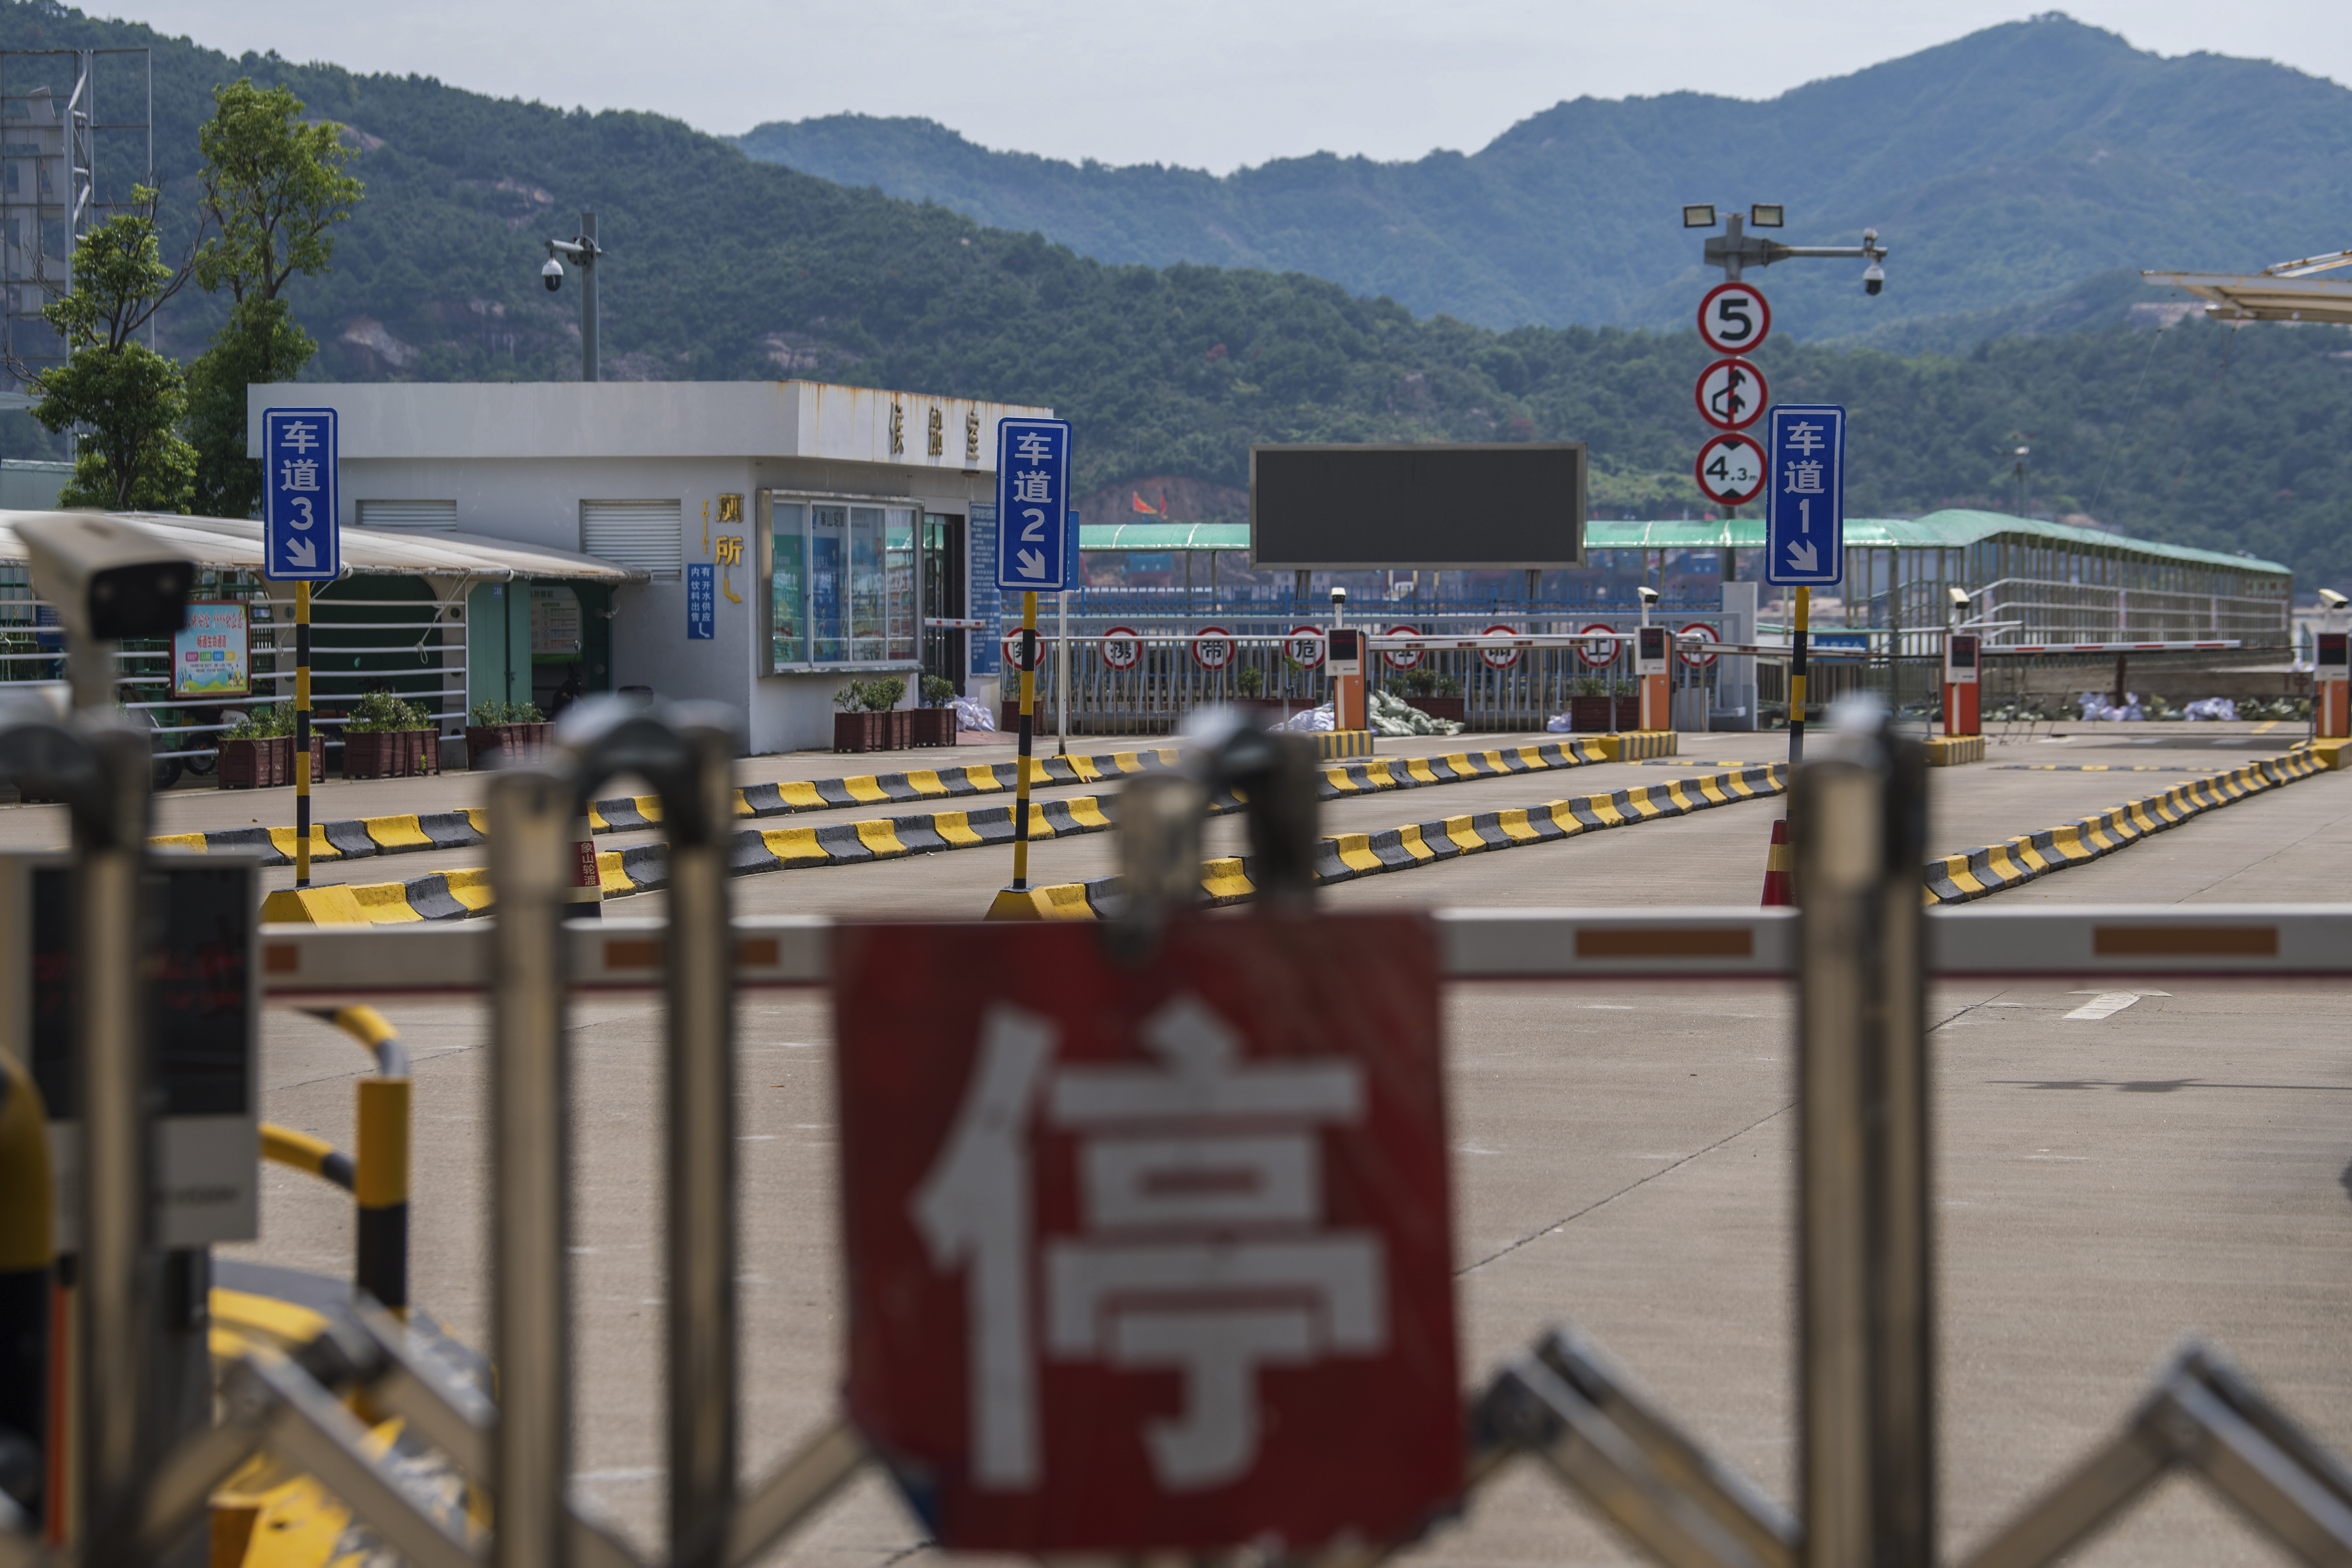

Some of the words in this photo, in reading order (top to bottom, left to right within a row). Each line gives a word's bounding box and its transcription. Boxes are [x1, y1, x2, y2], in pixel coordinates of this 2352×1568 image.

[1719, 298, 1752, 341] 5
[889, 401, 980, 461] 候船室
[280, 421, 320, 530] 车道3
[1013, 432, 1053, 542] 车道2
[1706, 456, 1758, 481] 4.3m
[1784, 421, 1825, 533] 车道1
[715, 494, 744, 566] 厕所
[580, 842, 597, 886] 象山轮渡
[909, 997, 1388, 1494] 停
